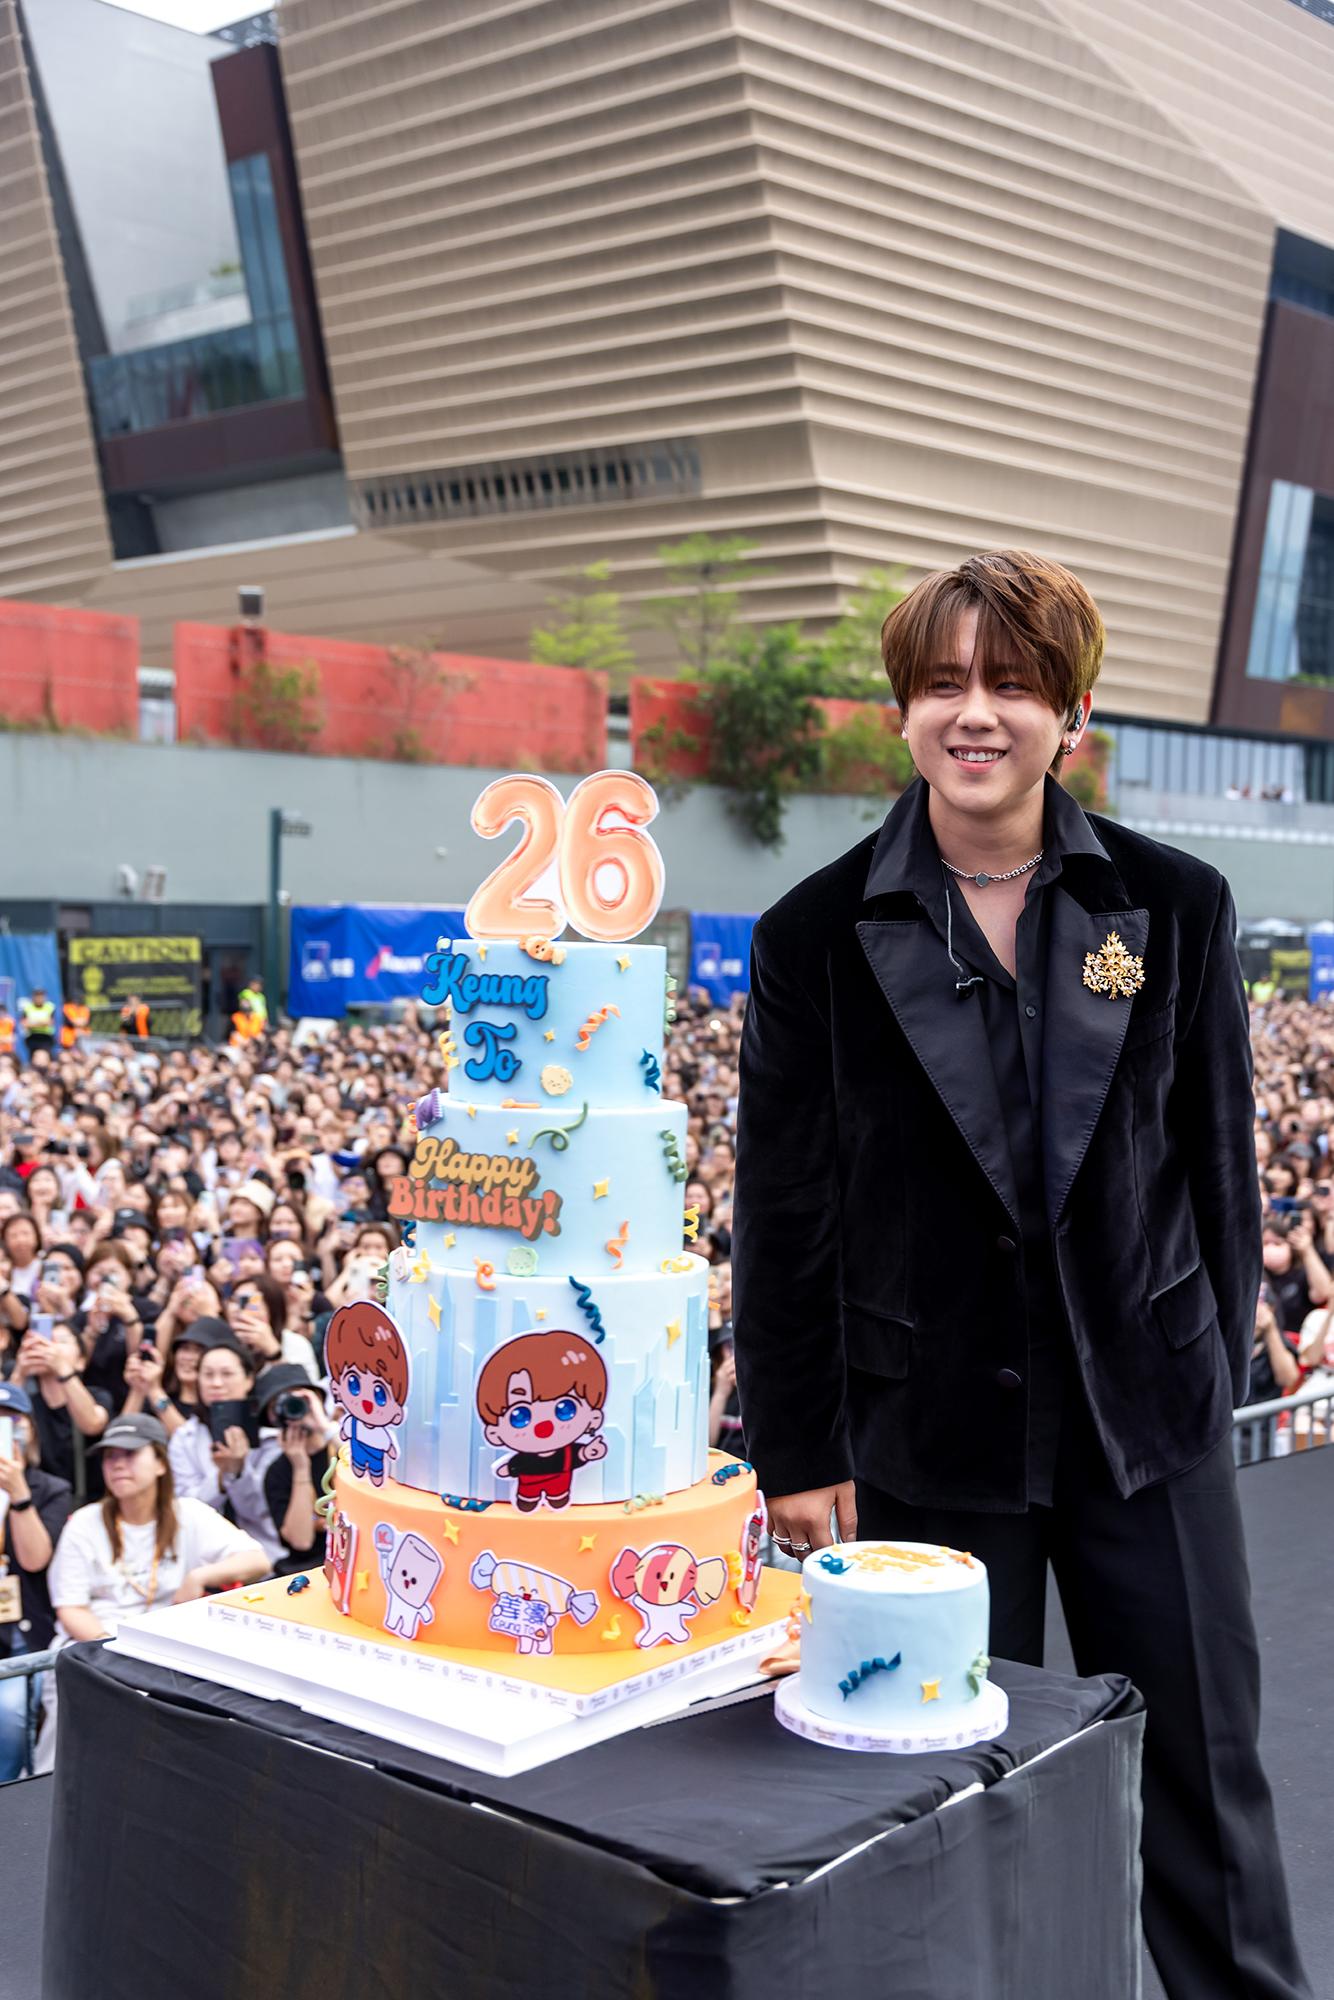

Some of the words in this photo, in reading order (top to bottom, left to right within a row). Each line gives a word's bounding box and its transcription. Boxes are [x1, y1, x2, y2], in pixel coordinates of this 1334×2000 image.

[463, 769, 665, 942] 26
[81, 941, 192, 964] CAUTION
[421, 953, 550, 1020] Keung
[464, 1021, 522, 1082] To
[409, 1136, 540, 1198] Happy
[387, 1175, 563, 1241] Birthday!
